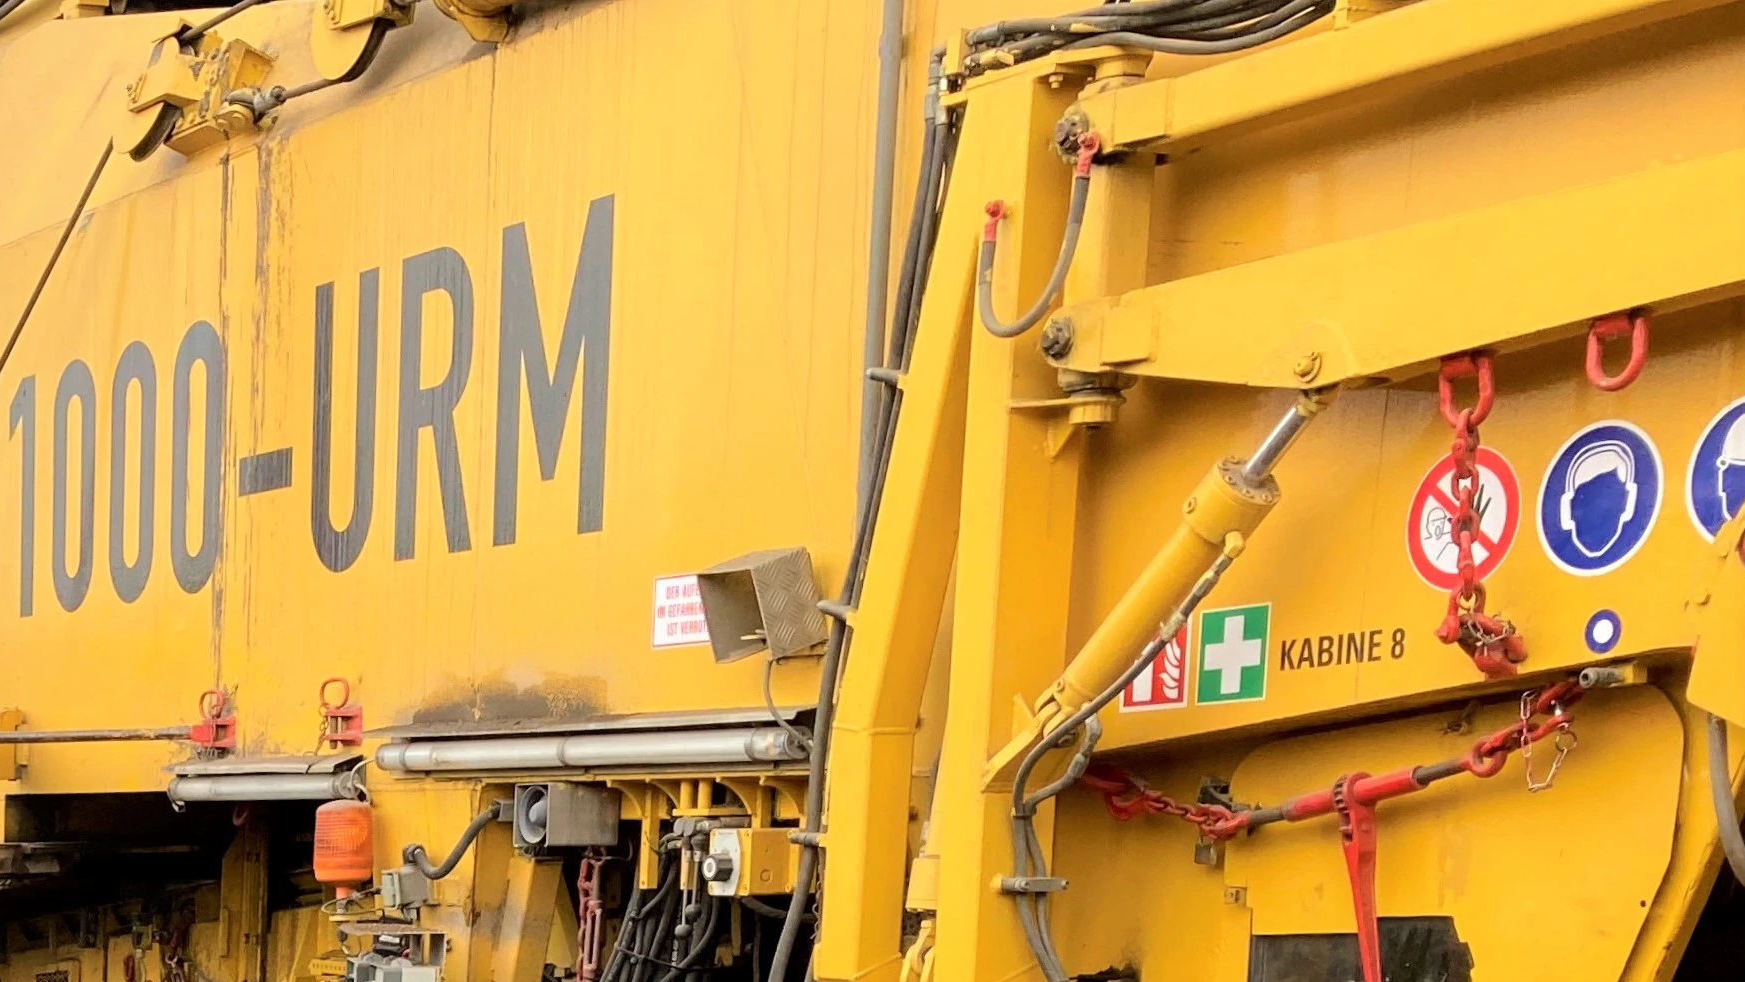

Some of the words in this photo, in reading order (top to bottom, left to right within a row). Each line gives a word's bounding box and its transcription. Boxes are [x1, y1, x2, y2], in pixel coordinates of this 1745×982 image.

[666, 586, 679, 599] DER
[667, 622, 678, 636] IST
[681, 620, 708, 635] VERBOT
[1279, 628, 1382, 671] KABINE
[1390, 627, 1406, 660] 8
